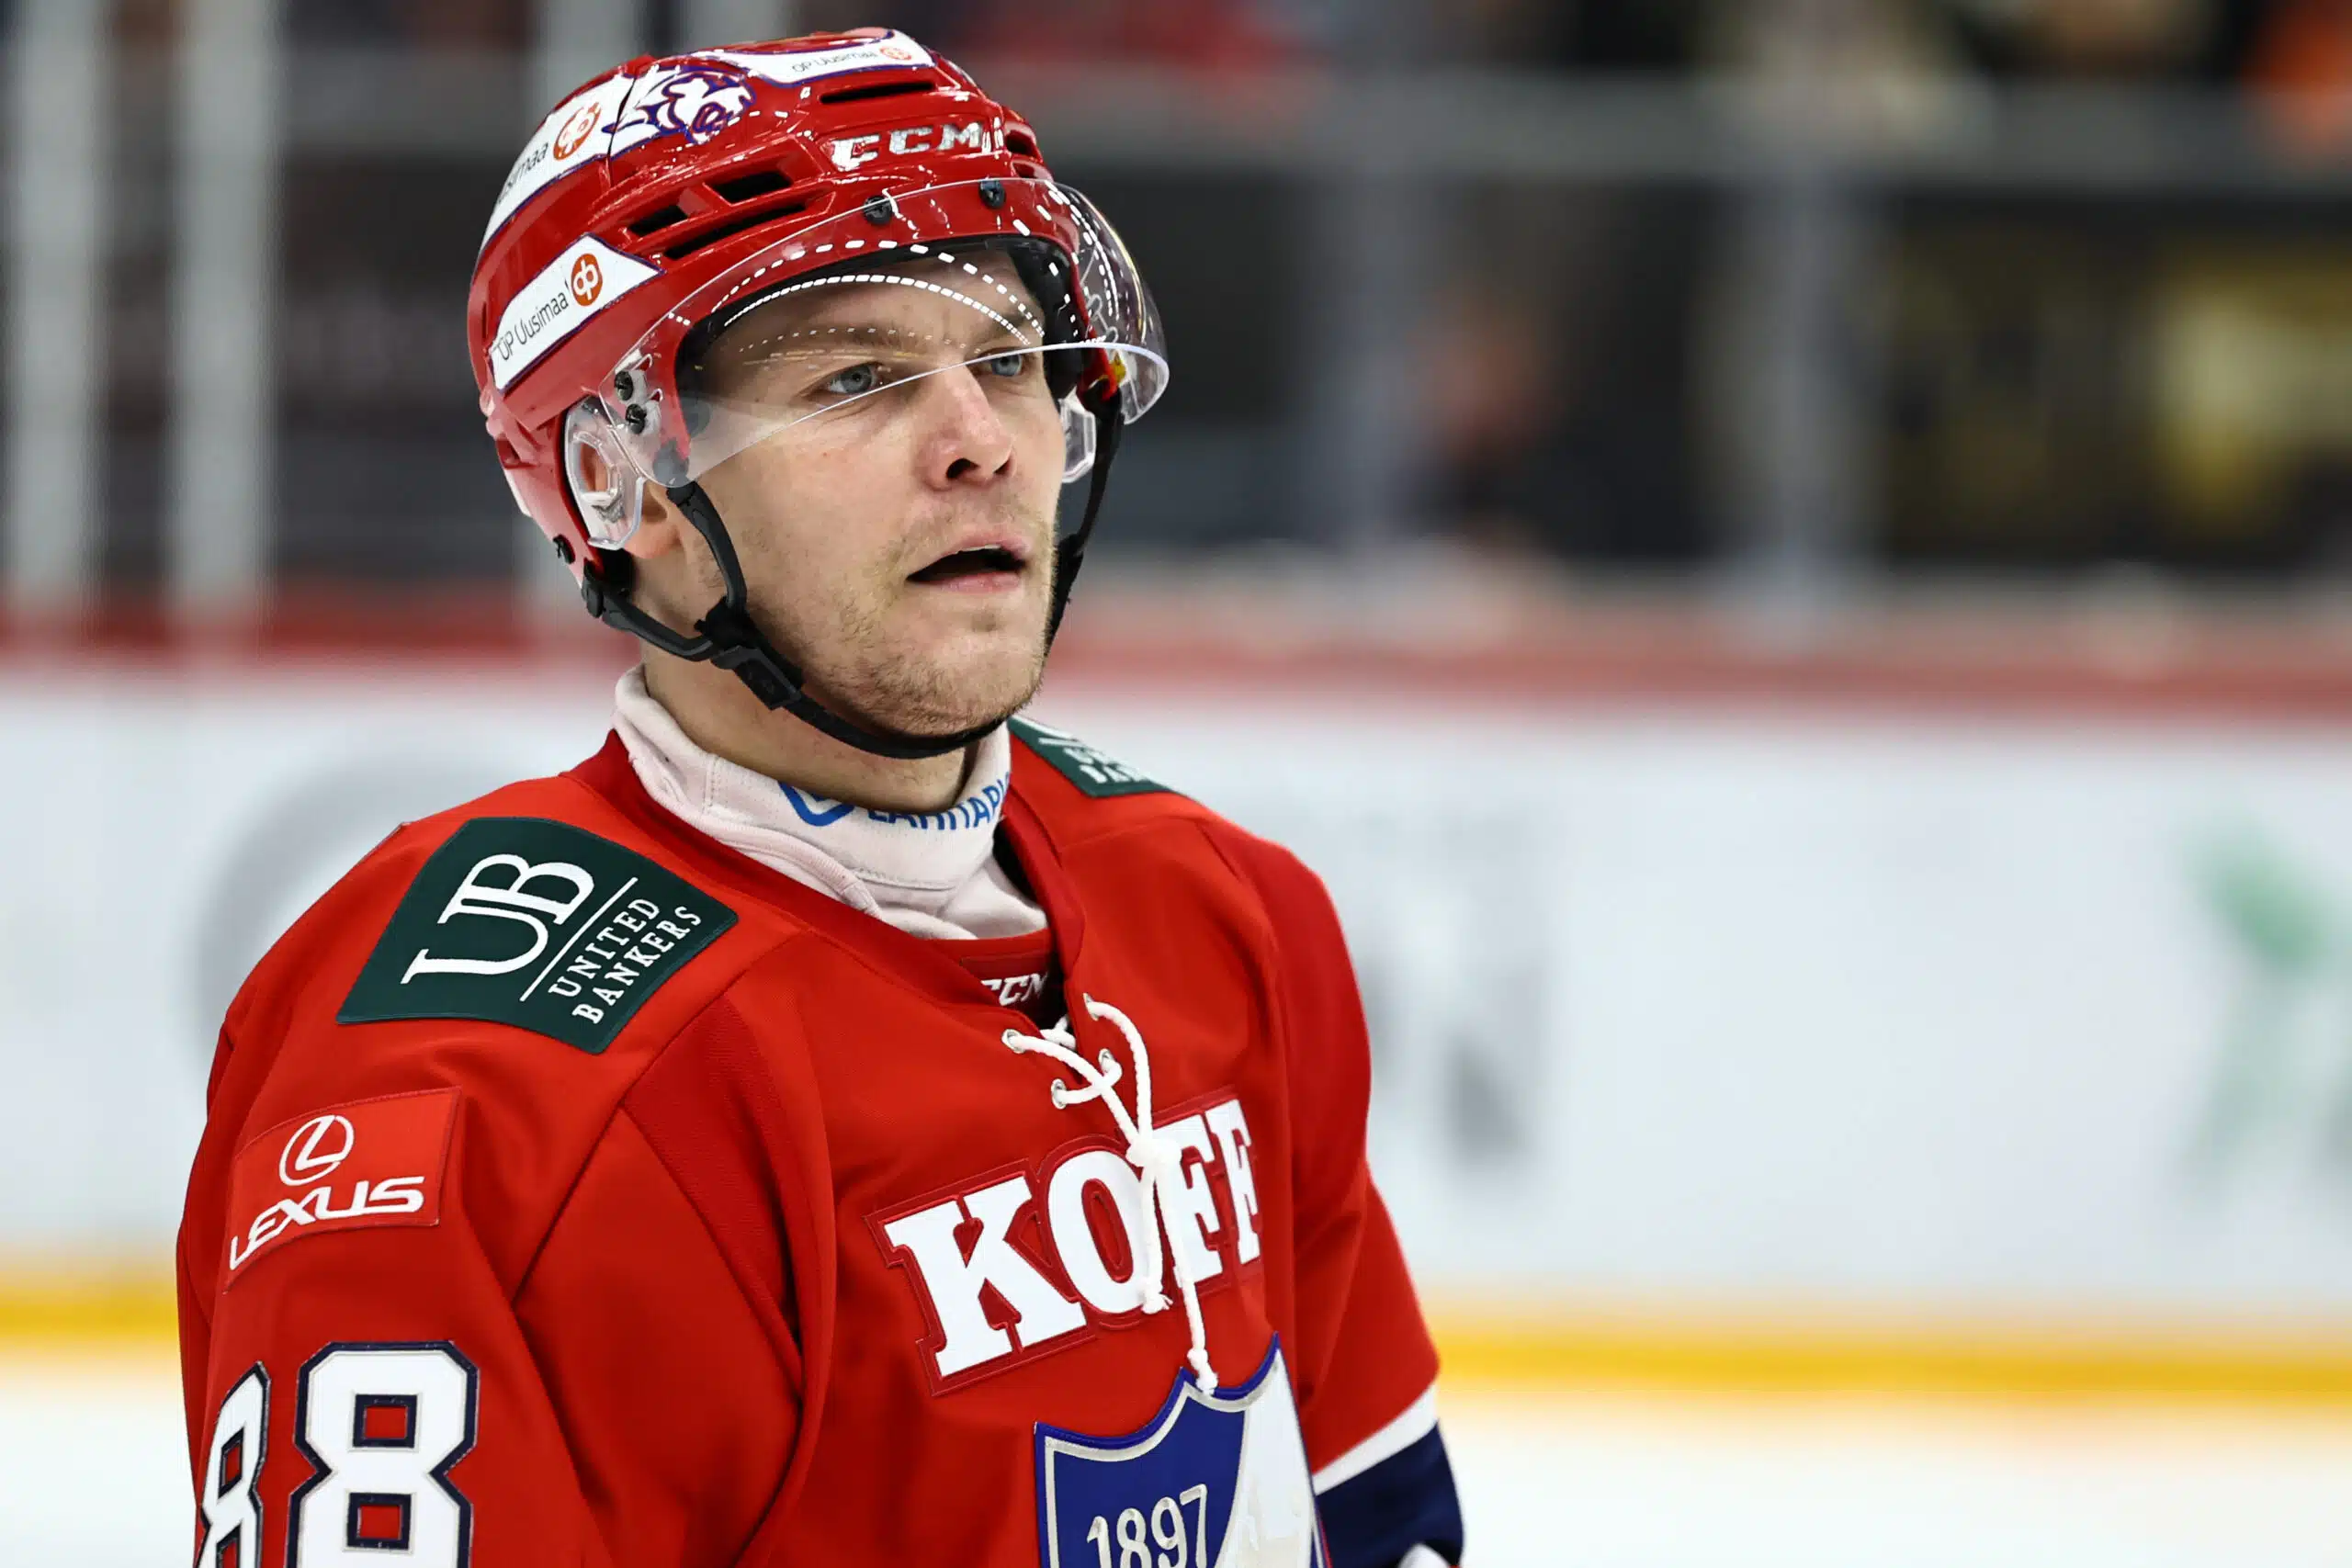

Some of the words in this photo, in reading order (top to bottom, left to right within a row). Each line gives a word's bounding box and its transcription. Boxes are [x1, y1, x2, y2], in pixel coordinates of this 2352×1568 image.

[831, 121, 982, 173] CCM
[514, 291, 570, 346] Uusimaa
[400, 853, 594, 984] UB
[548, 898, 661, 998] UNITED
[571, 906, 702, 1025] BANKERS
[229, 1176, 425, 1271] LEXUS
[883, 1099, 1261, 1378] KOFF
[191, 1339, 481, 1568] 88
[1086, 1483, 1208, 1568] 1897
